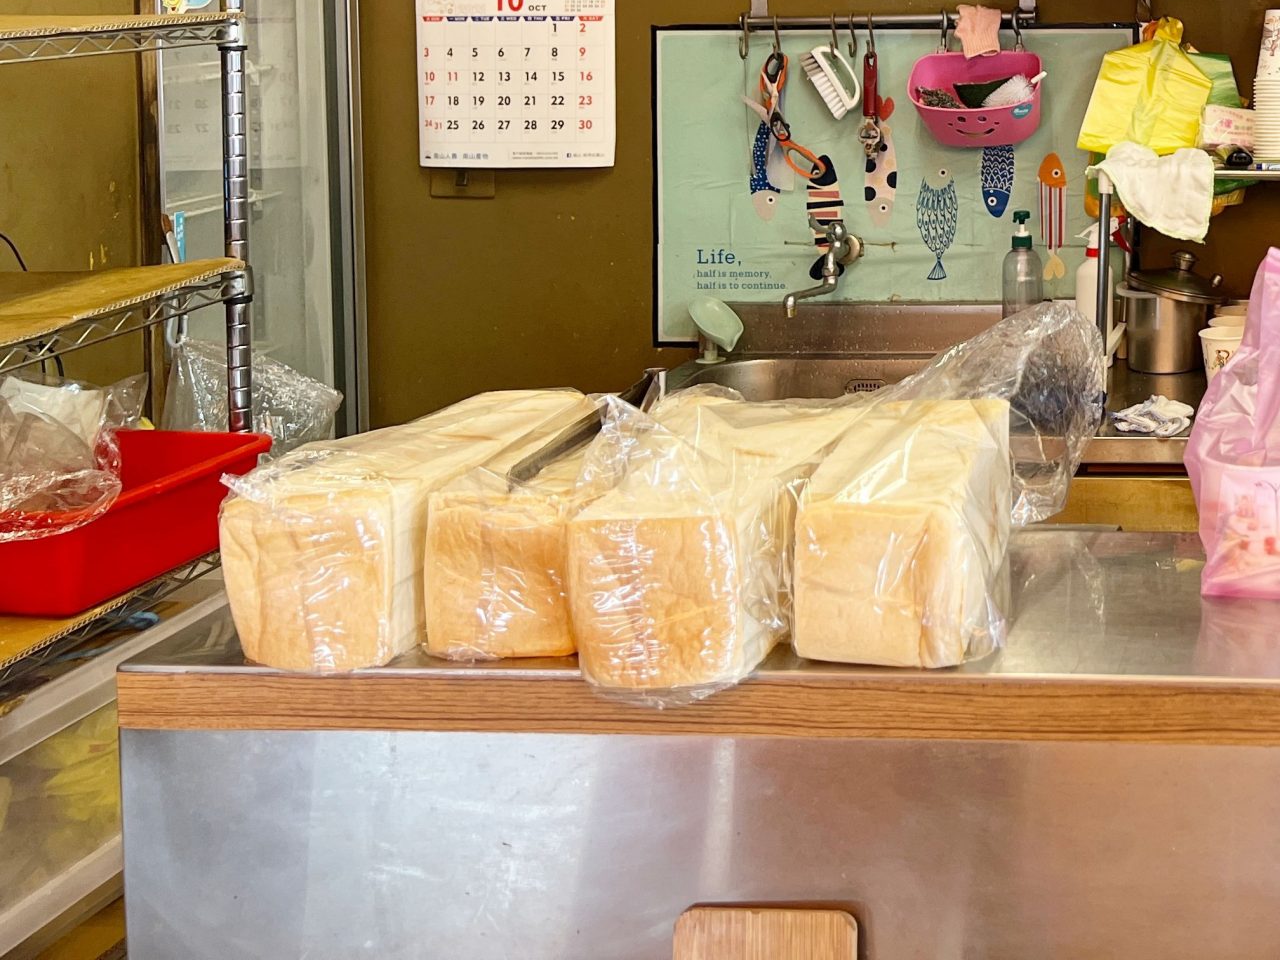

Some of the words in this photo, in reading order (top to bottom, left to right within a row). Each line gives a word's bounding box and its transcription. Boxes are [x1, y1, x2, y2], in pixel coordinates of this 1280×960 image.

[528, 4, 547, 12] OCT
[552, 24, 557, 32] 1
[580, 23, 586, 32] 2
[424, 48, 429, 57] 3
[447, 48, 453, 57] 4
[472, 48, 478, 57] 5
[498, 48, 504, 57] 6
[524, 48, 530, 57] 7
[552, 48, 558, 57] 8
[579, 48, 586, 57] 9
[424, 72, 435, 82] 10
[448, 72, 458, 82] 11
[473, 72, 484, 82] 12
[498, 72, 510, 82] 13
[525, 72, 538, 82] 14
[552, 72, 564, 82] 15
[580, 72, 593, 82] 16
[424, 96, 435, 106] 17
[448, 96, 459, 106] 18
[472, 96, 484, 106] 19
[498, 96, 510, 106] 20
[524, 96, 536, 106] 21
[551, 96, 564, 106] 22
[578, 96, 593, 106] 23
[446, 120, 459, 130] 25
[472, 120, 484, 130] 26
[498, 120, 510, 130] 27
[524, 120, 537, 130] 28
[551, 120, 564, 130] 29
[578, 120, 592, 130] 30
[697, 249, 742, 266] Life,
[697, 270, 717, 278] half
[718, 270, 727, 278] is
[697, 282, 717, 290] half
[718, 282, 727, 290] is
[729, 282, 740, 290] to
